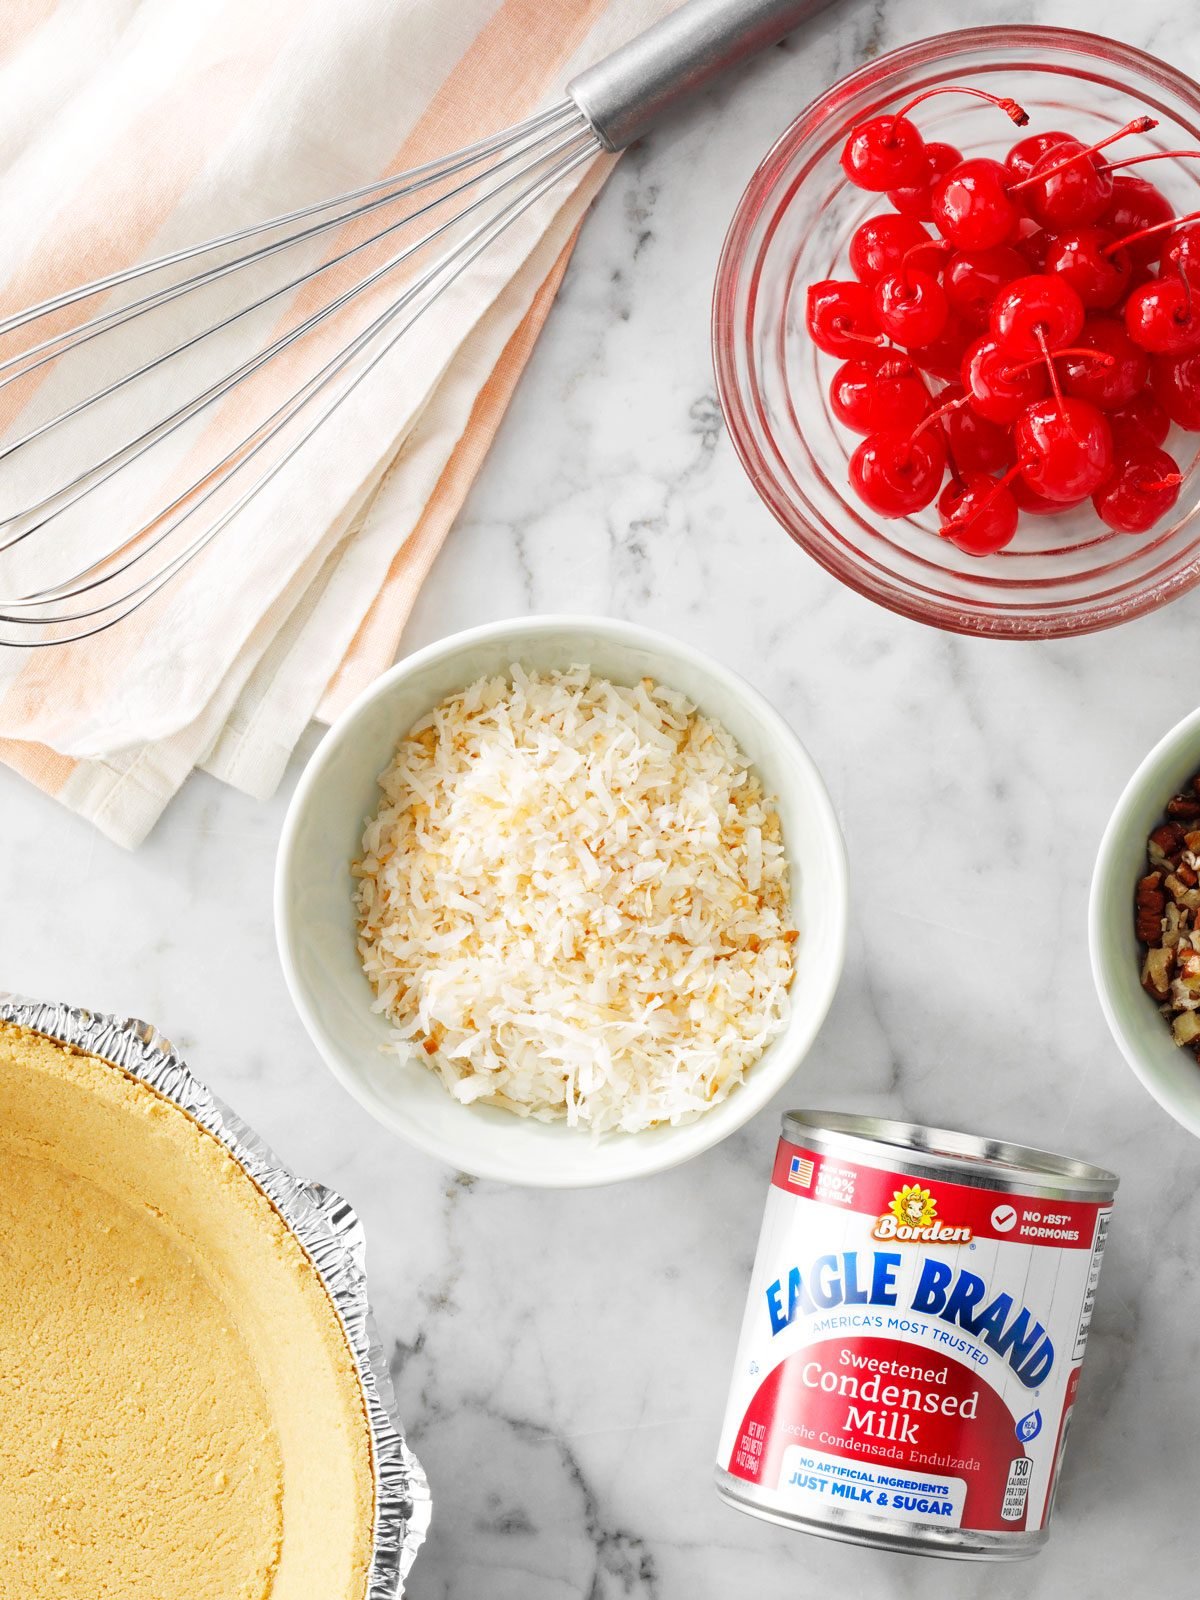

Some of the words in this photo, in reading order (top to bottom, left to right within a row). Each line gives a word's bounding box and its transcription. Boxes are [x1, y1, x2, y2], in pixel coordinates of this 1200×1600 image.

[818, 1172, 855, 1194] 100%
[828, 1189, 853, 1204] MILK
[874, 1214, 971, 1242] Borden
[1022, 1210, 1041, 1222] NO
[1020, 1225, 1080, 1241] HORMONES
[766, 1251, 902, 1338] EAGLE
[910, 1258, 1055, 1389] BRAND
[812, 1315, 883, 1335] AMERICA'S
[888, 1318, 929, 1336] MOST
[933, 1328, 989, 1367] TRUSTED
[839, 1349, 948, 1385] Sweetened
[802, 1363, 980, 1420] Condensed
[842, 1406, 920, 1445] Milk
[1024, 1421, 1036, 1430] REAL
[781, 1421, 816, 1441] Leche
[819, 1431, 904, 1460] Condensada
[909, 1450, 981, 1471] Endulzada
[800, 1457, 815, 1469] NO
[816, 1461, 875, 1483] ARTIFICIAL
[877, 1476, 949, 1495] INGREDIENTS
[1008, 1478, 1028, 1486] CALORIES
[1014, 1460, 1029, 1476] 130
[788, 1472, 828, 1493] JUST
[831, 1482, 874, 1503] MILK
[876, 1493, 889, 1507] &
[892, 1495, 954, 1517] SUGAR
